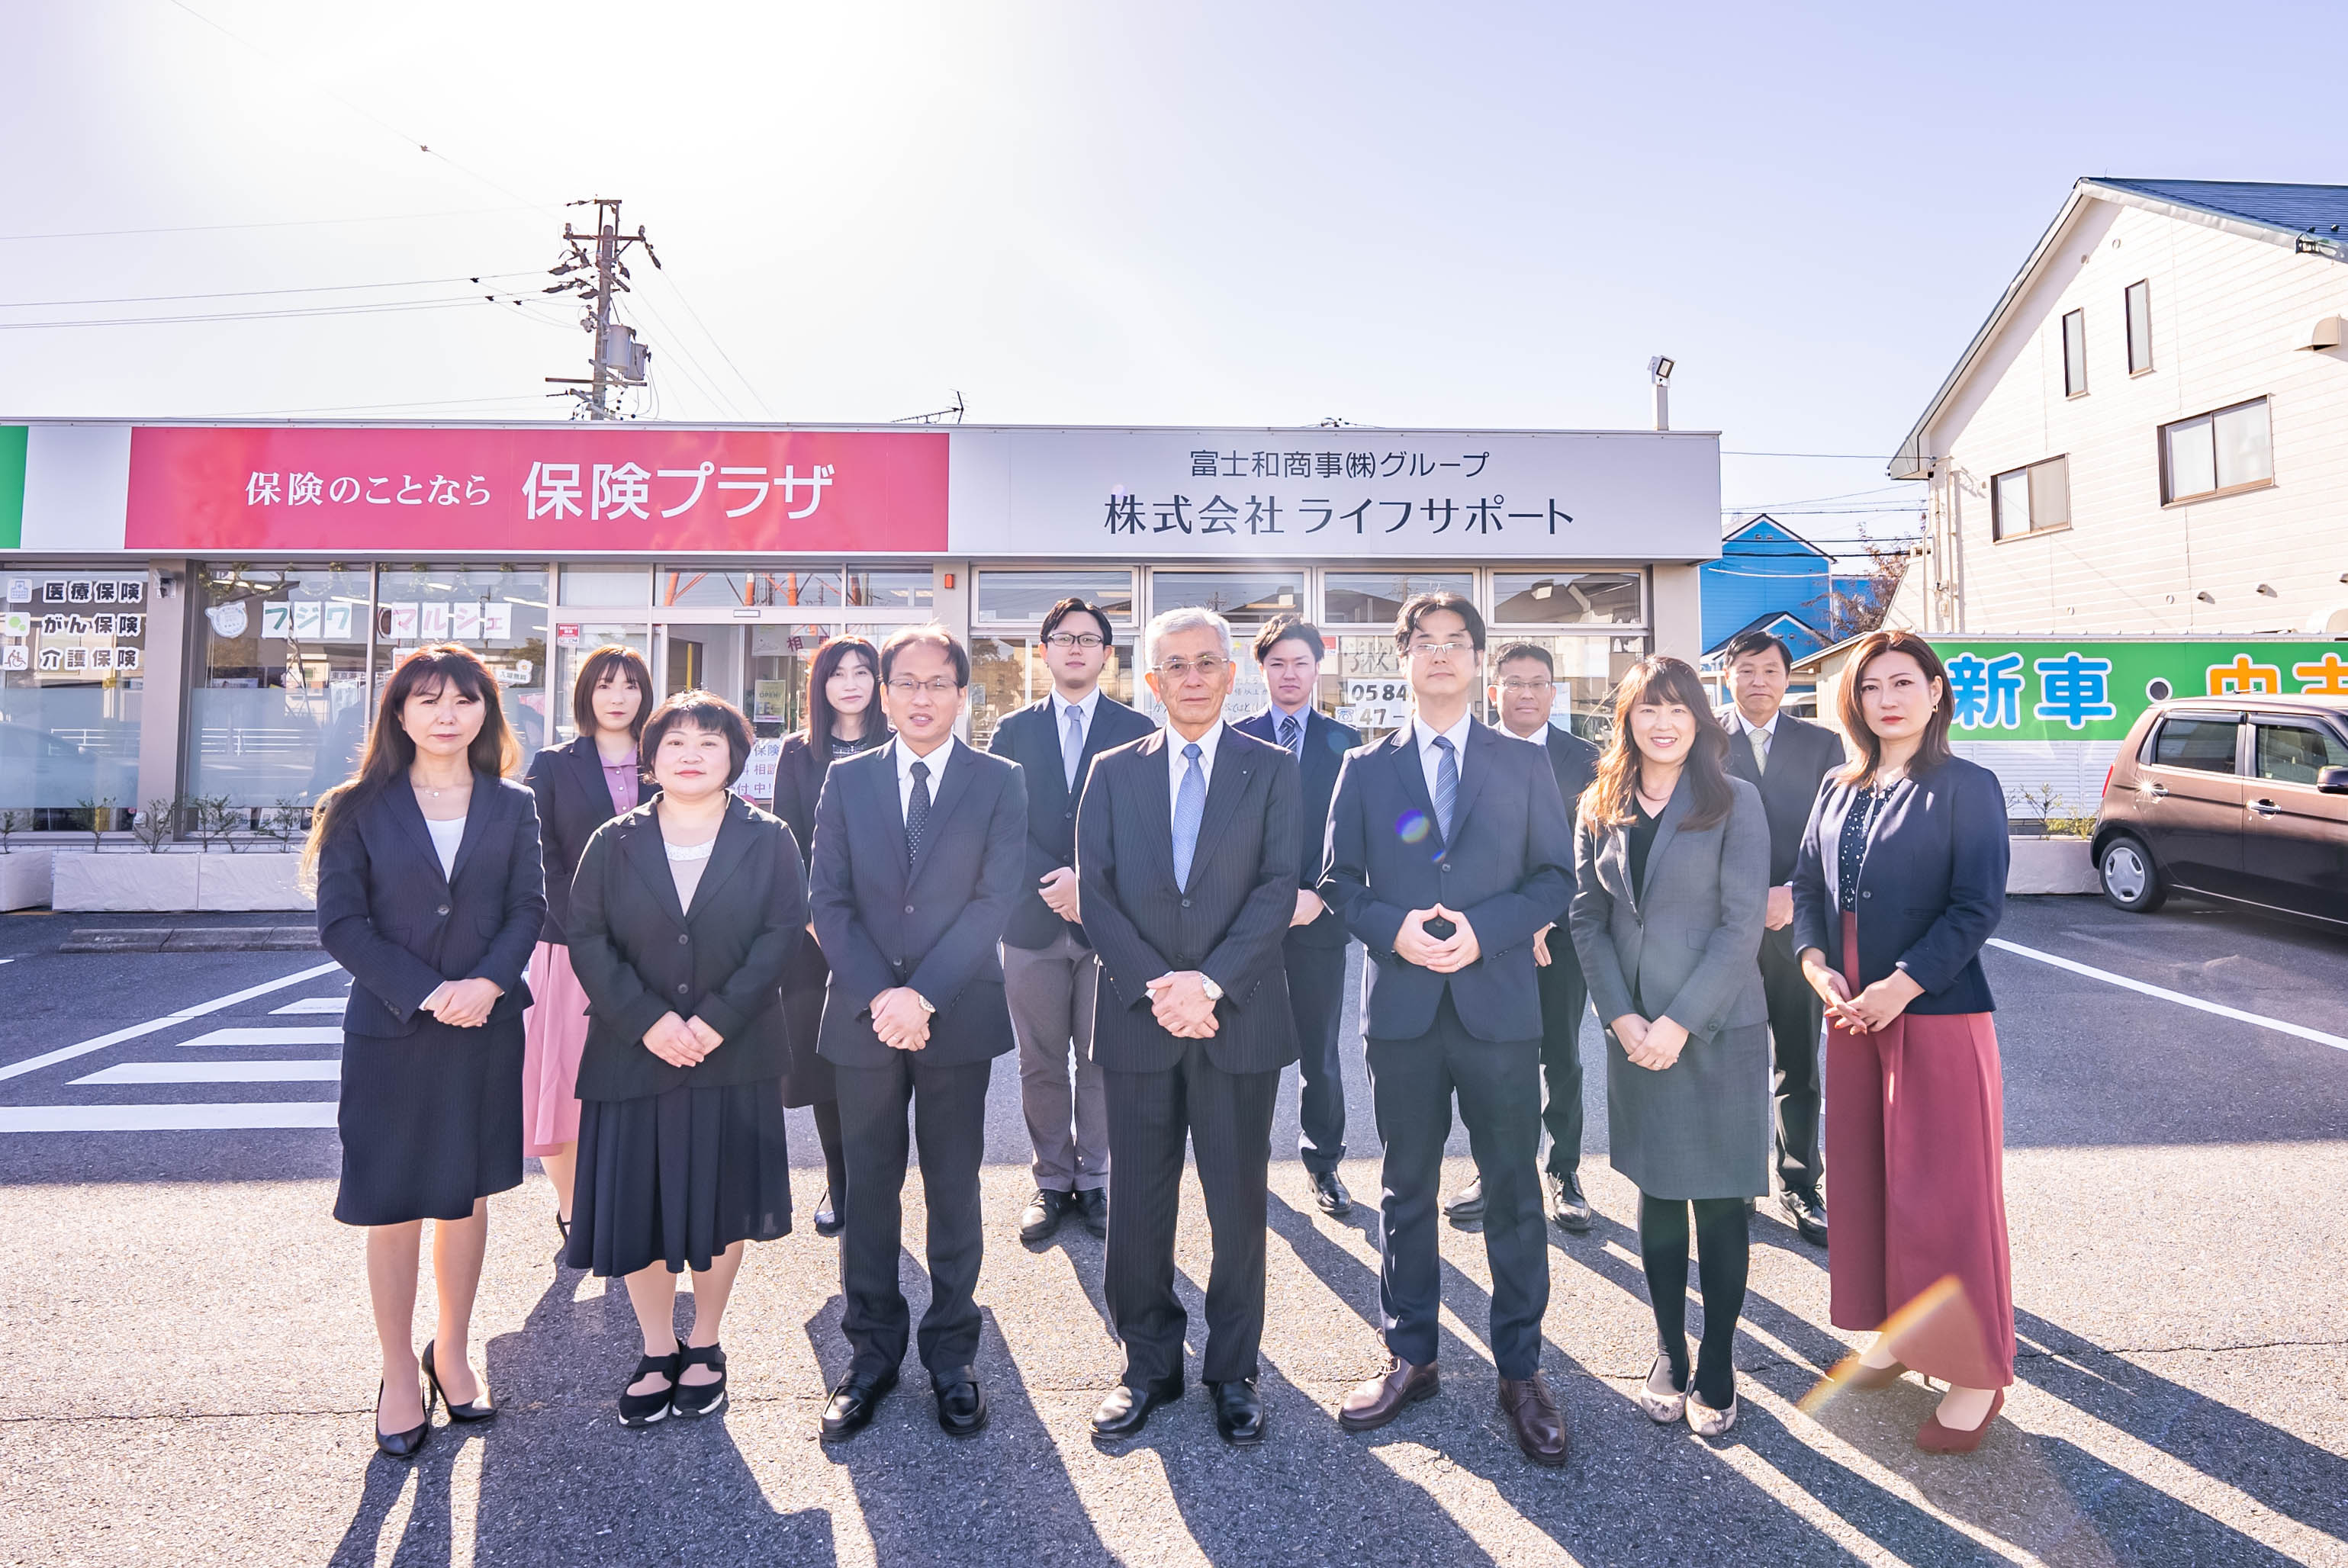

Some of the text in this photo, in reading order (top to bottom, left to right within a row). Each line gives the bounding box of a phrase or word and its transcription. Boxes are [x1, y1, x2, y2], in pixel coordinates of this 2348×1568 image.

[245, 461, 836, 521] 保険のことなら 保険プラザ
[45, 582, 141, 602] 医療保険
[43, 615, 140, 635] がん保険
[264, 606, 350, 631] フジワ
[393, 607, 503, 631] マルシェ
[40, 649, 137, 668] 介護保険
[1351, 683, 1407, 702] 0584
[734, 782, 772, 795] 付中!
